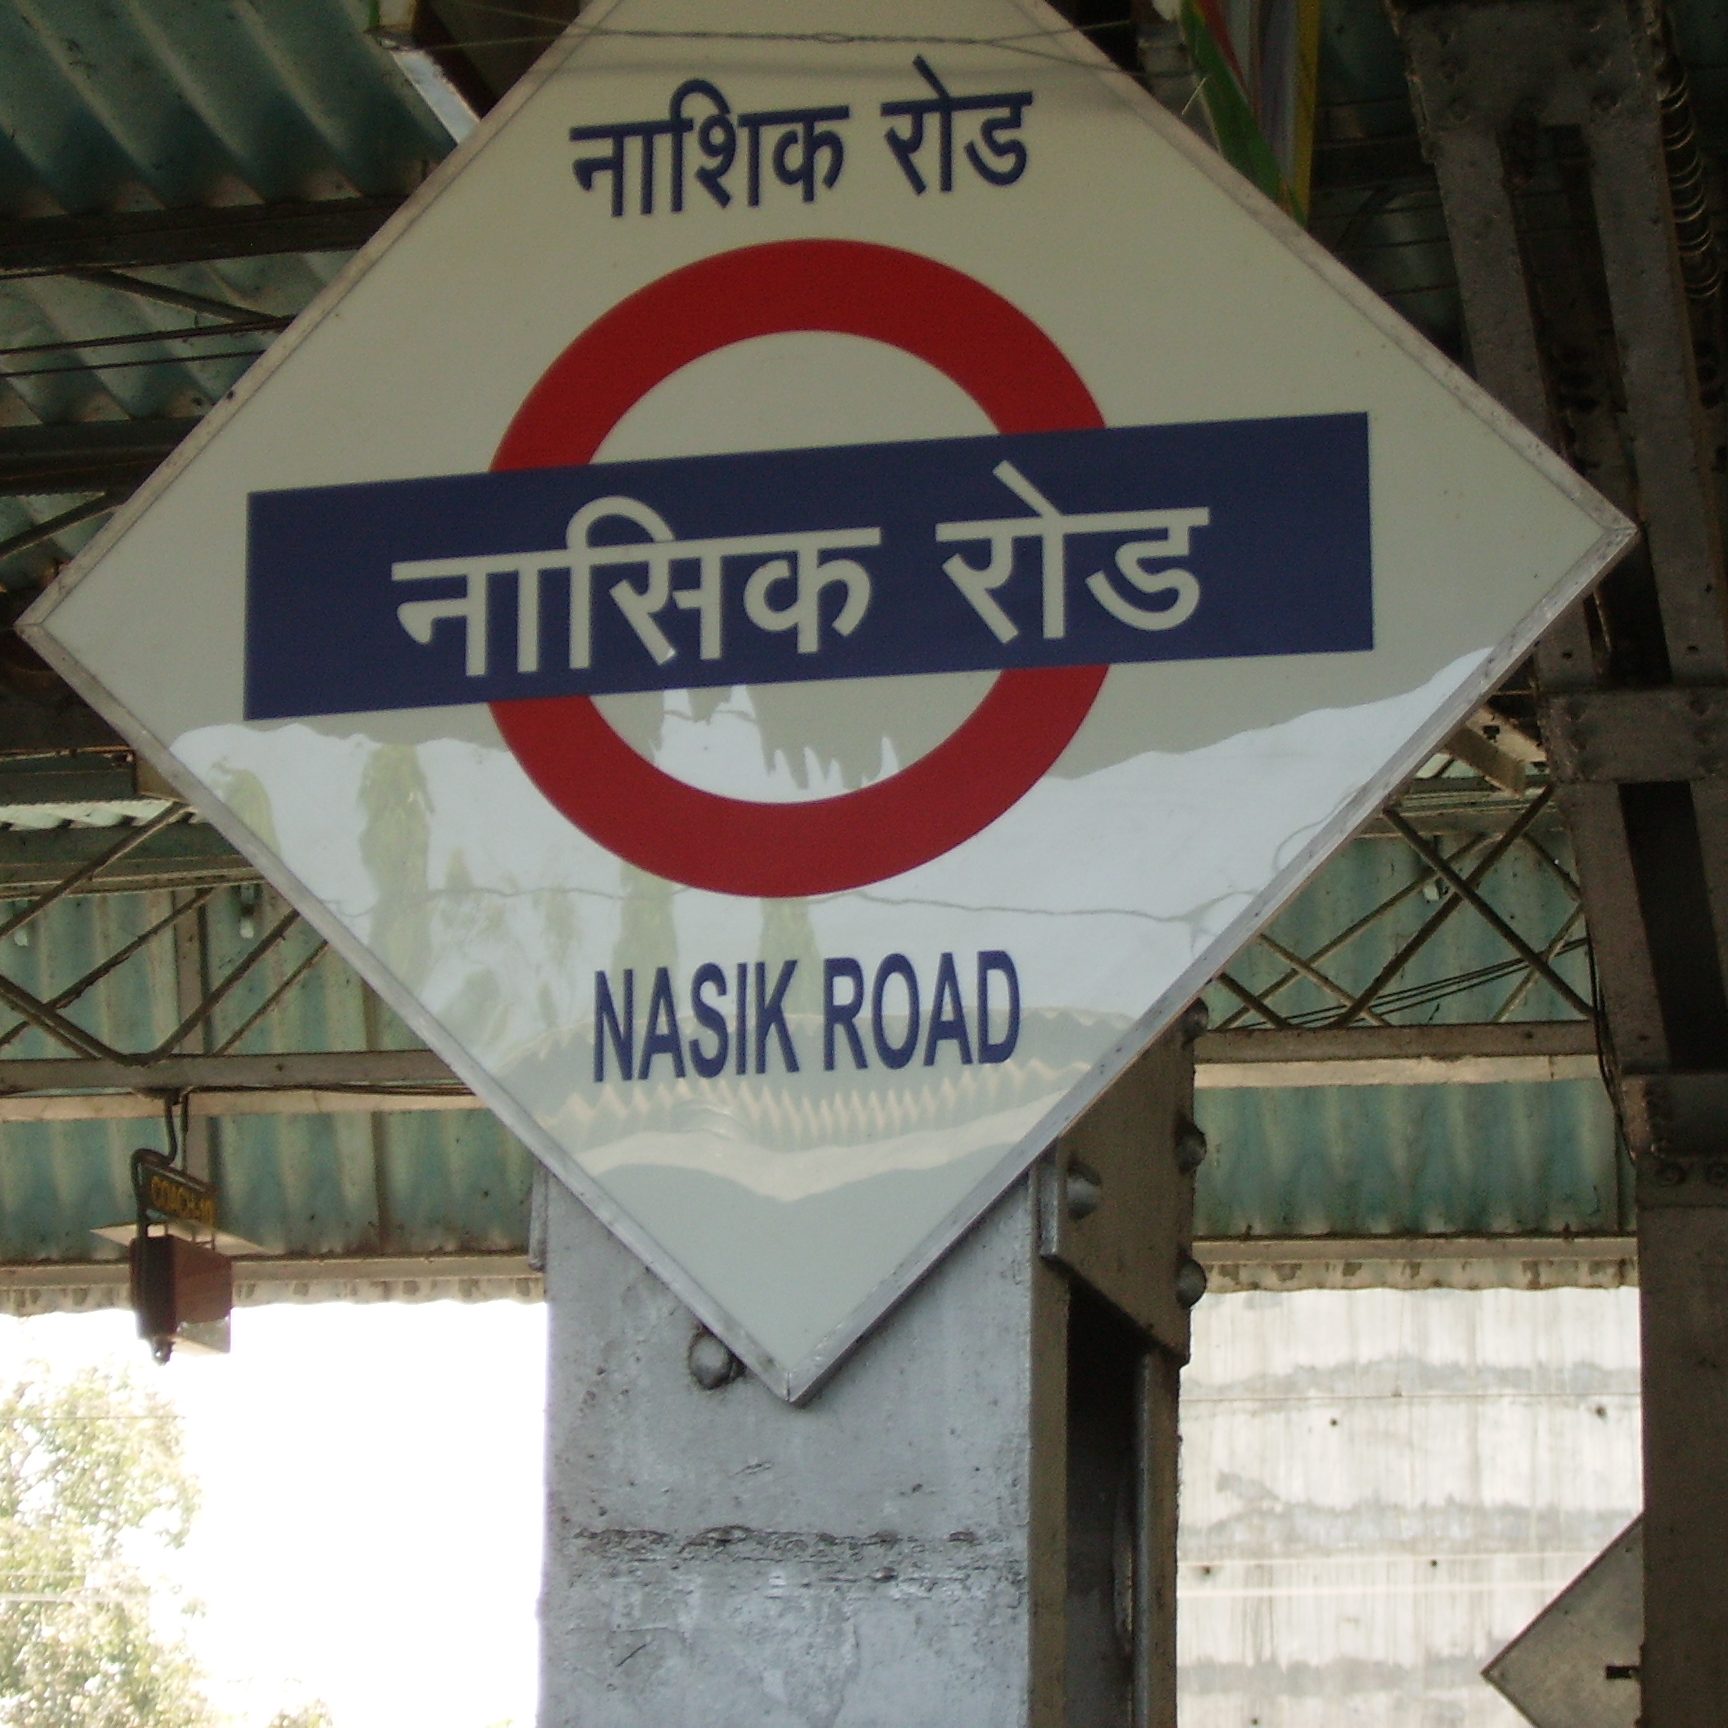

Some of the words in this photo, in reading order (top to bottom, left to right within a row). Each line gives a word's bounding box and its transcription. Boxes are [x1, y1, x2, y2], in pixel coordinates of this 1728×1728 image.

[569, 78, 850, 217] नाशिक
[880, 54, 1034, 195] रोड
[391, 495, 882, 677] नासिक
[935, 460, 1210, 644] रोड
[593, 959, 800, 1083] NASIK
[823, 950, 1021, 1072] ROAD
